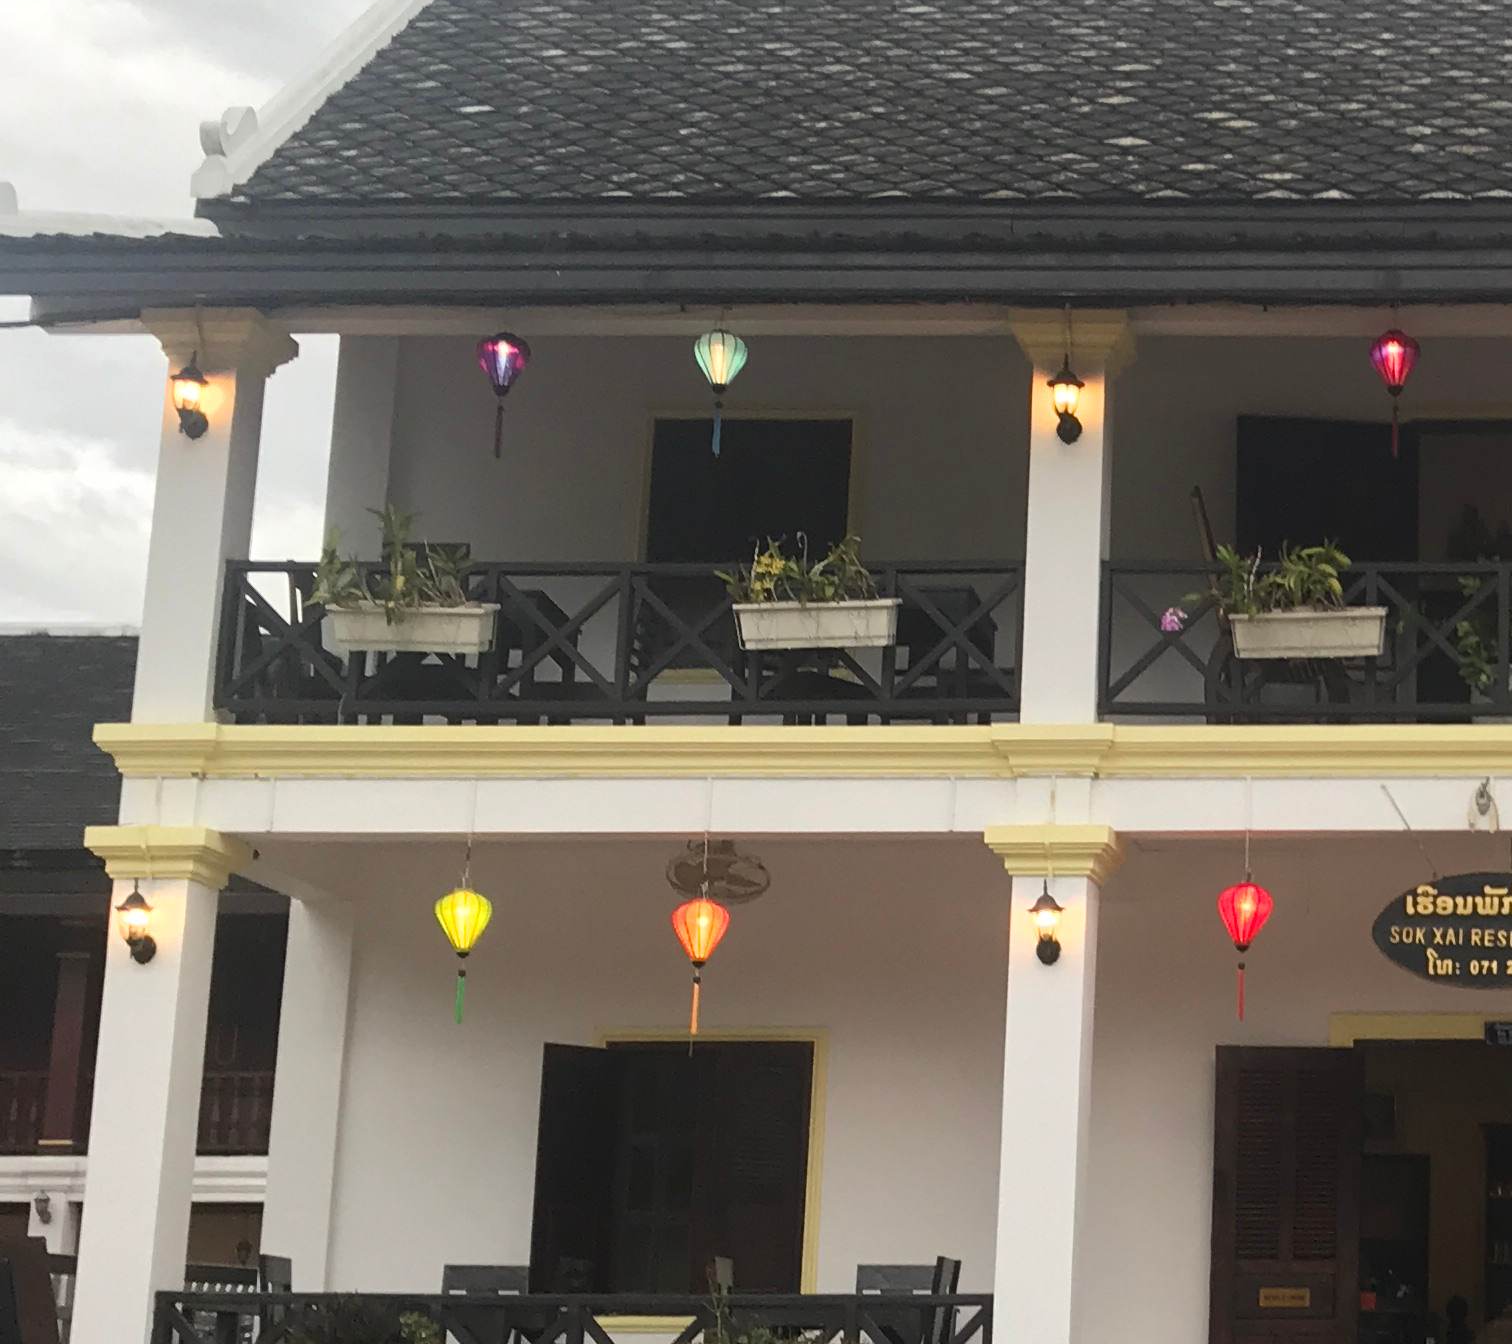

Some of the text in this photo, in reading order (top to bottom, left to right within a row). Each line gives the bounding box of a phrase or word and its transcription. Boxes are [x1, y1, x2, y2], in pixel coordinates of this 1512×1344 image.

[1390, 925, 1426, 944] SOK
[1432, 927, 1463, 946] XAI
[1469, 959, 1498, 976] 071
